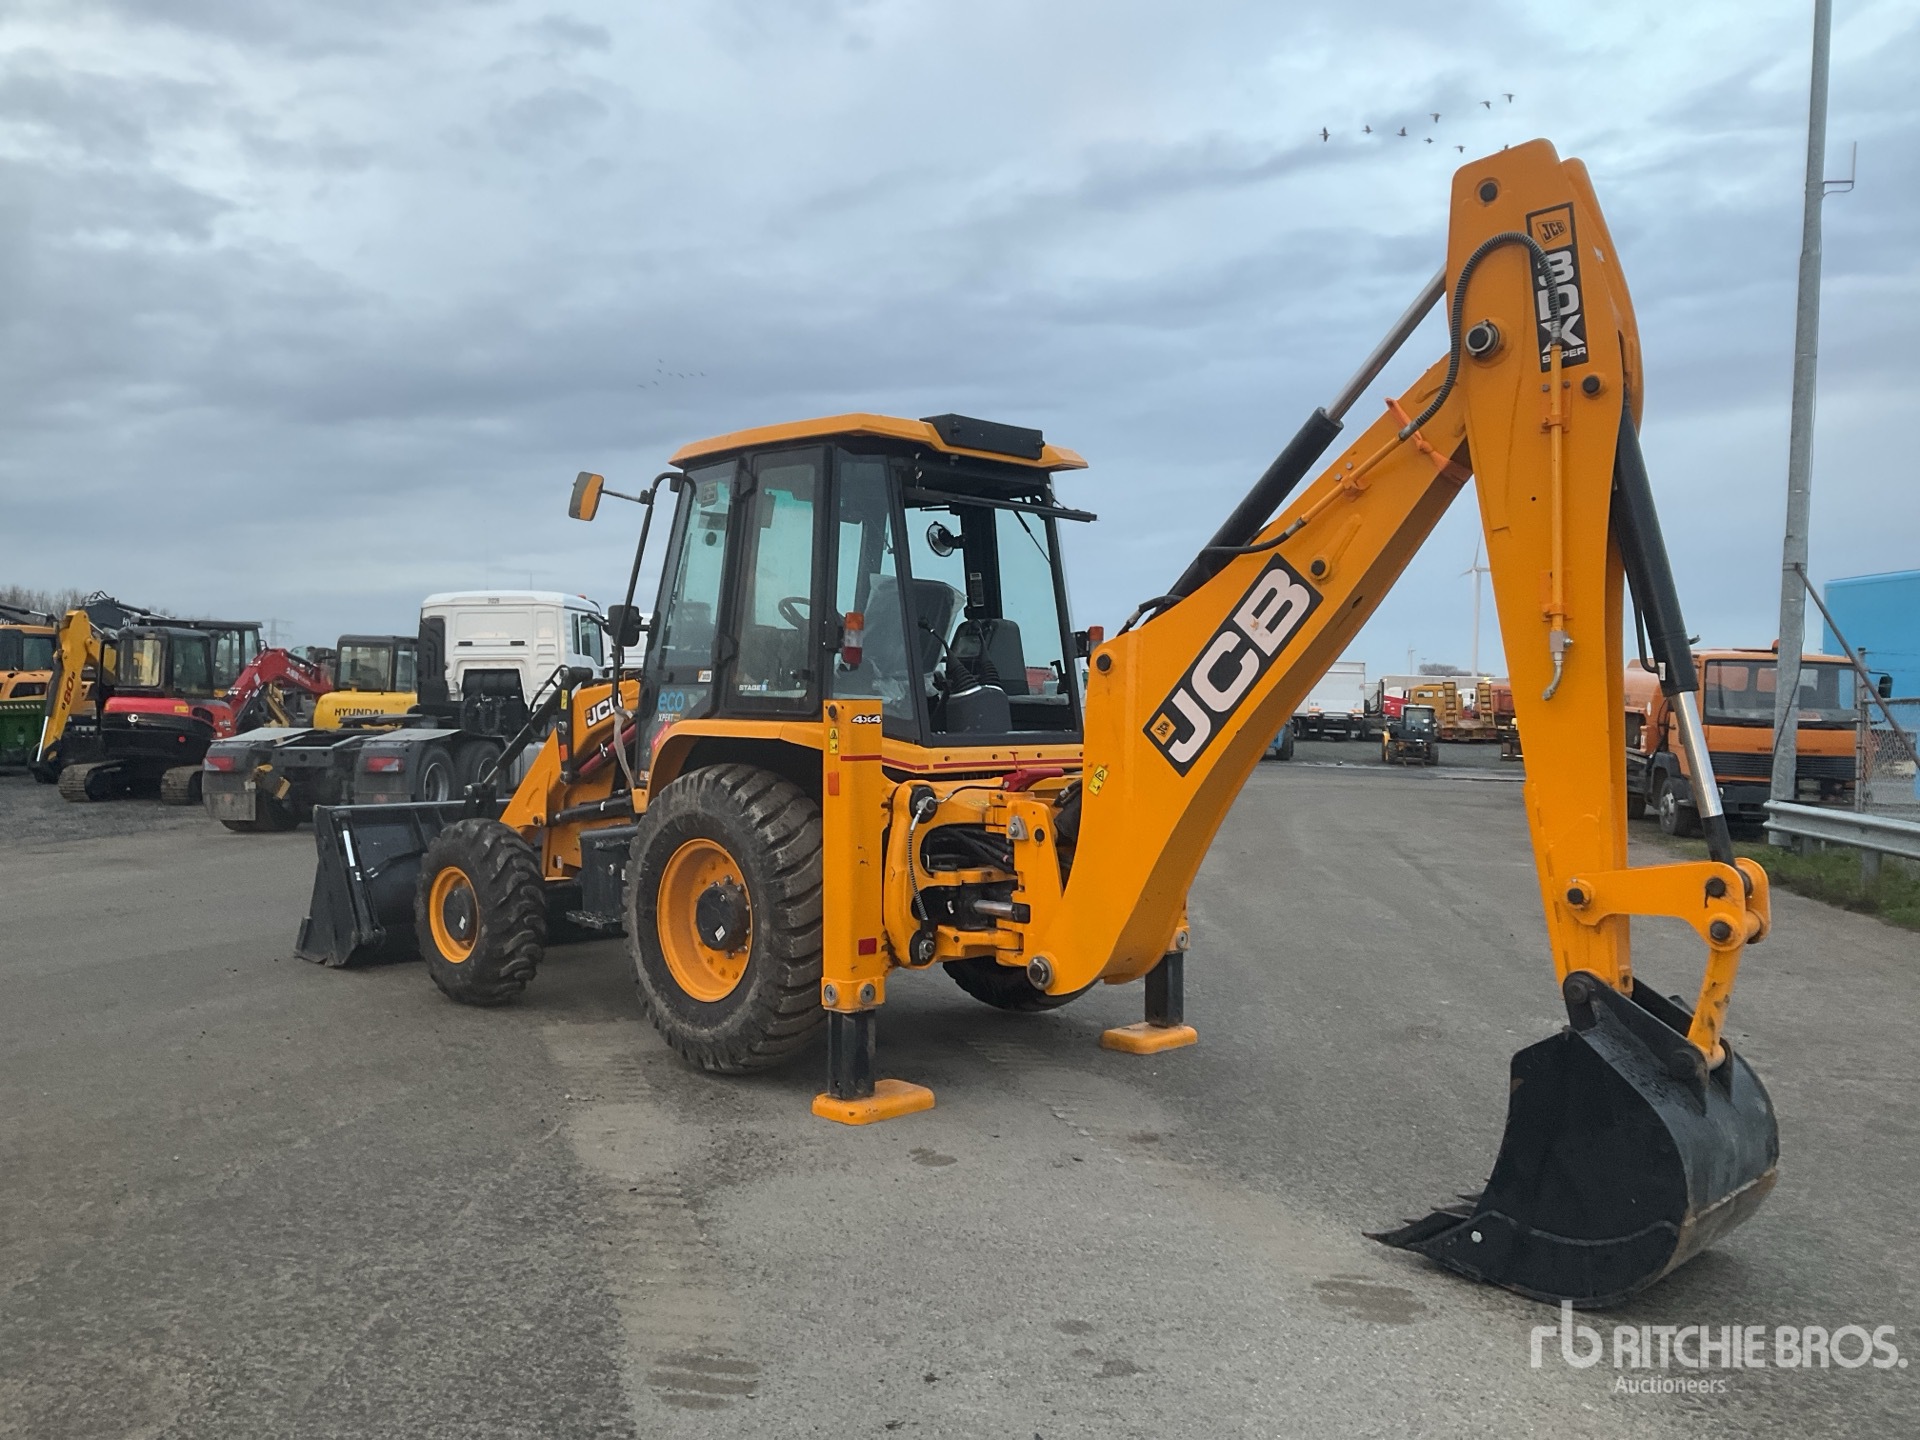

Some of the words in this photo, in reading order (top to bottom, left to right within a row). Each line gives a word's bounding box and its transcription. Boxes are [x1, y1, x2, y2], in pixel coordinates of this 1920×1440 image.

[1541, 221, 1565, 241] JCB
[1537, 251, 1585, 353] 3DX
[1542, 347, 1587, 364] SPER
[1168, 568, 1311, 763] JCB
[658, 691, 684, 711] eco
[334, 708, 385, 716] HYUNDAI
